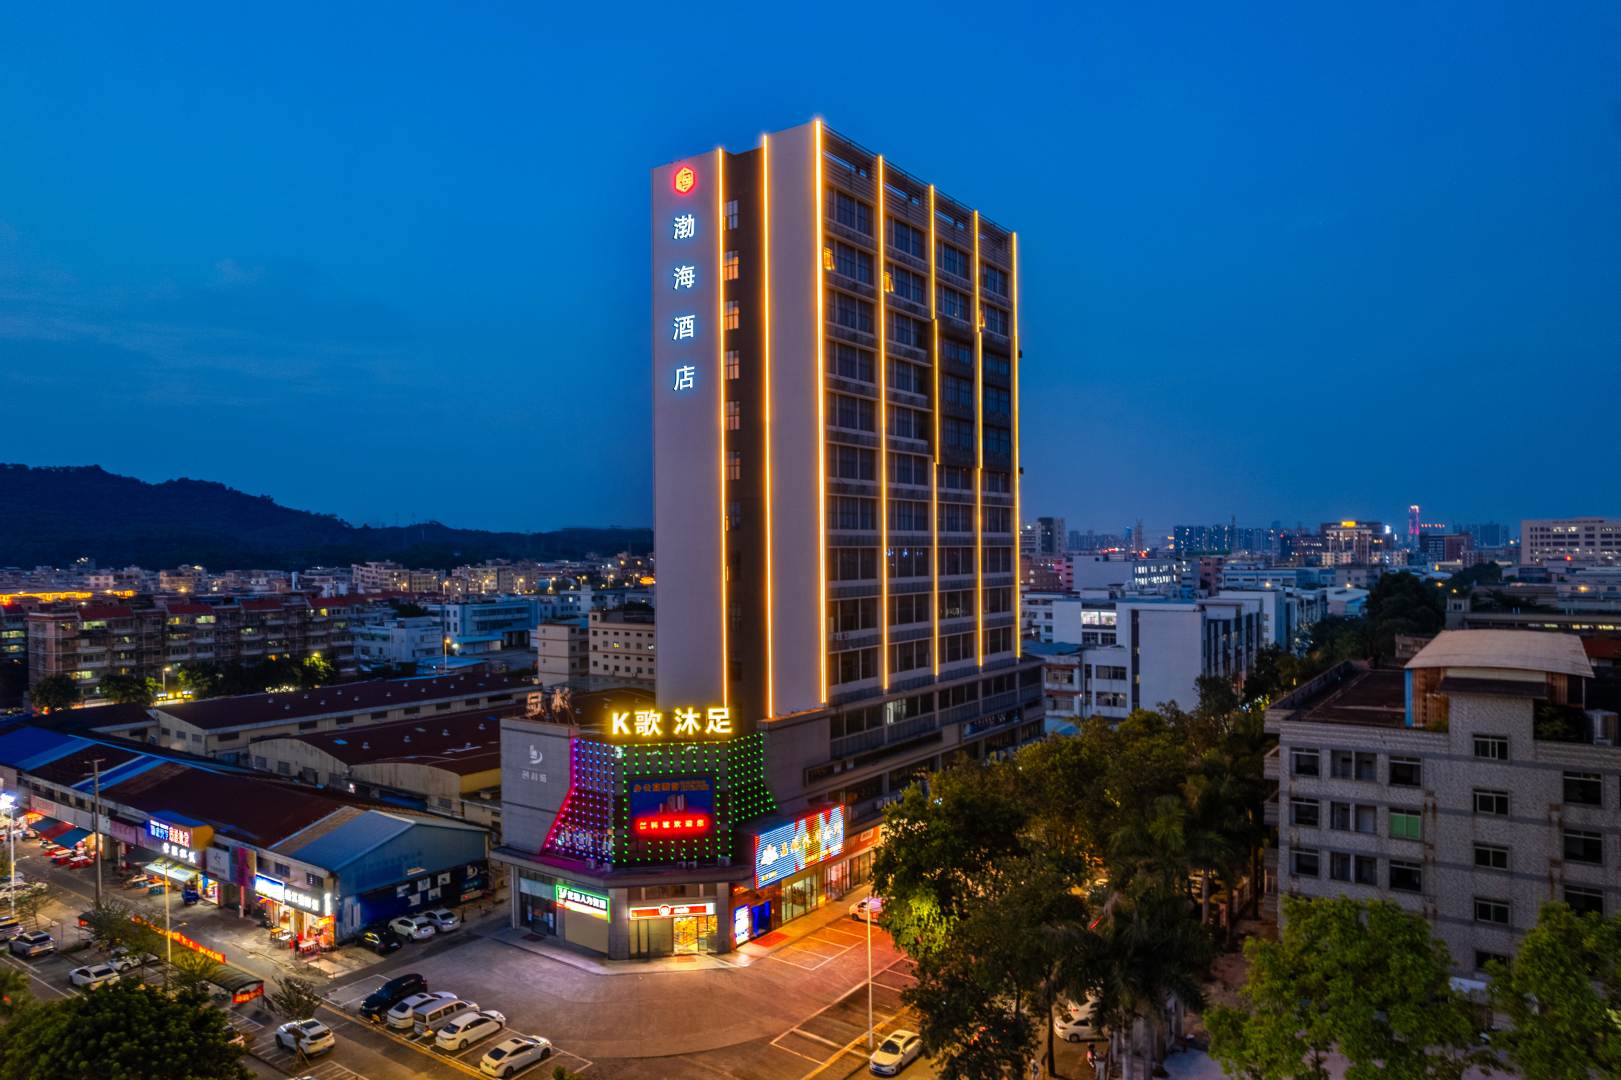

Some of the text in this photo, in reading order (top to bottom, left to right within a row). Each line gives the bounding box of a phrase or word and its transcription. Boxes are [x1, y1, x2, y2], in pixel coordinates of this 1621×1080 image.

[673, 213, 696, 392] 渤海酒店
[611, 706, 733, 737] K歌 沐足
